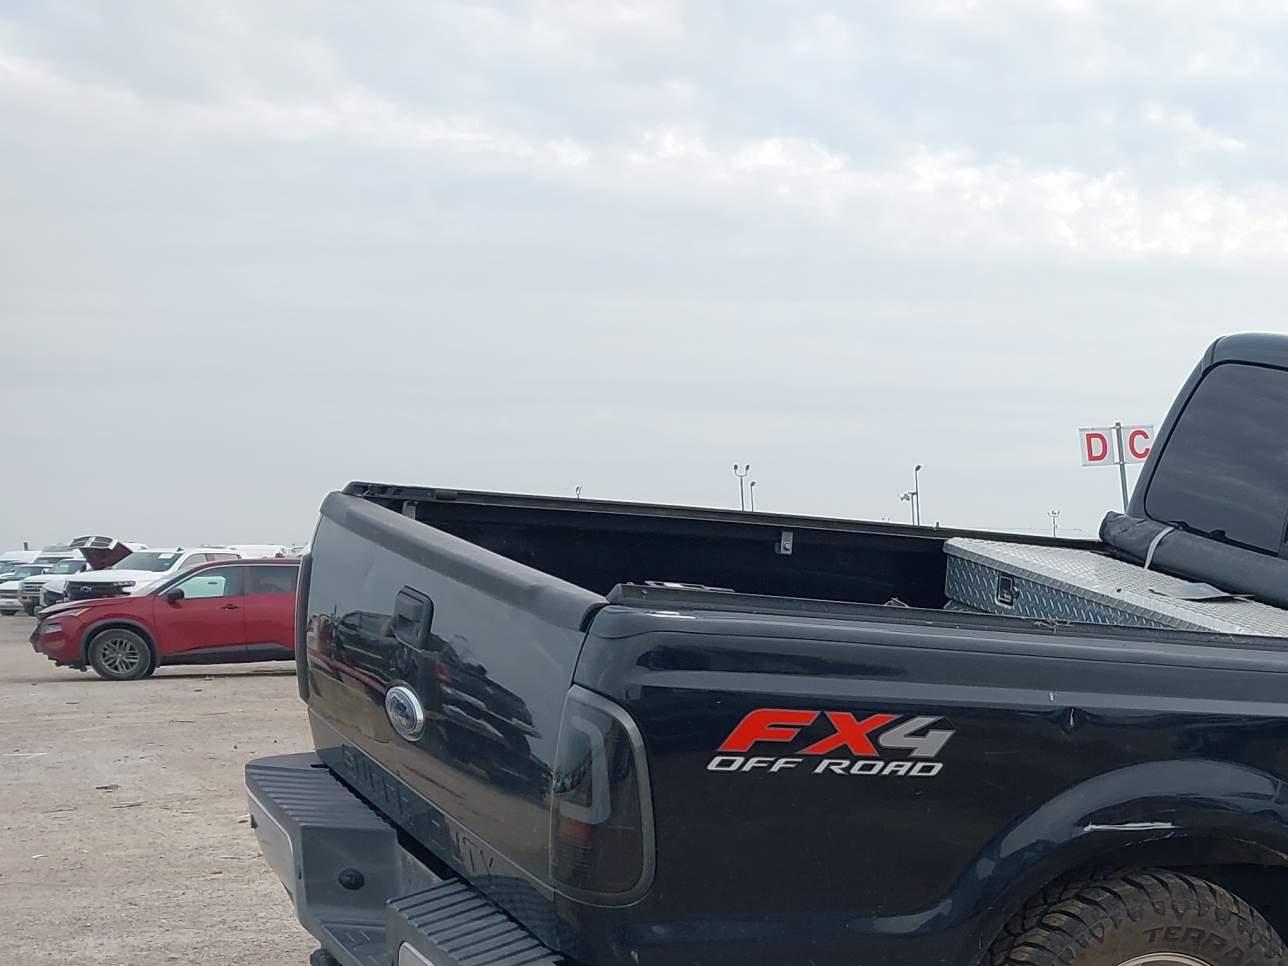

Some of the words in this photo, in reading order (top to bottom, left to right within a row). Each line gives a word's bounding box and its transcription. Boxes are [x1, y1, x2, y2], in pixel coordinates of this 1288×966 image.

[1085, 432, 1108, 462] D
[1128, 429, 1151, 459] C
[716, 708, 957, 757] FX4
[707, 756, 804, 772] OFF
[811, 759, 944, 776] ROAD
